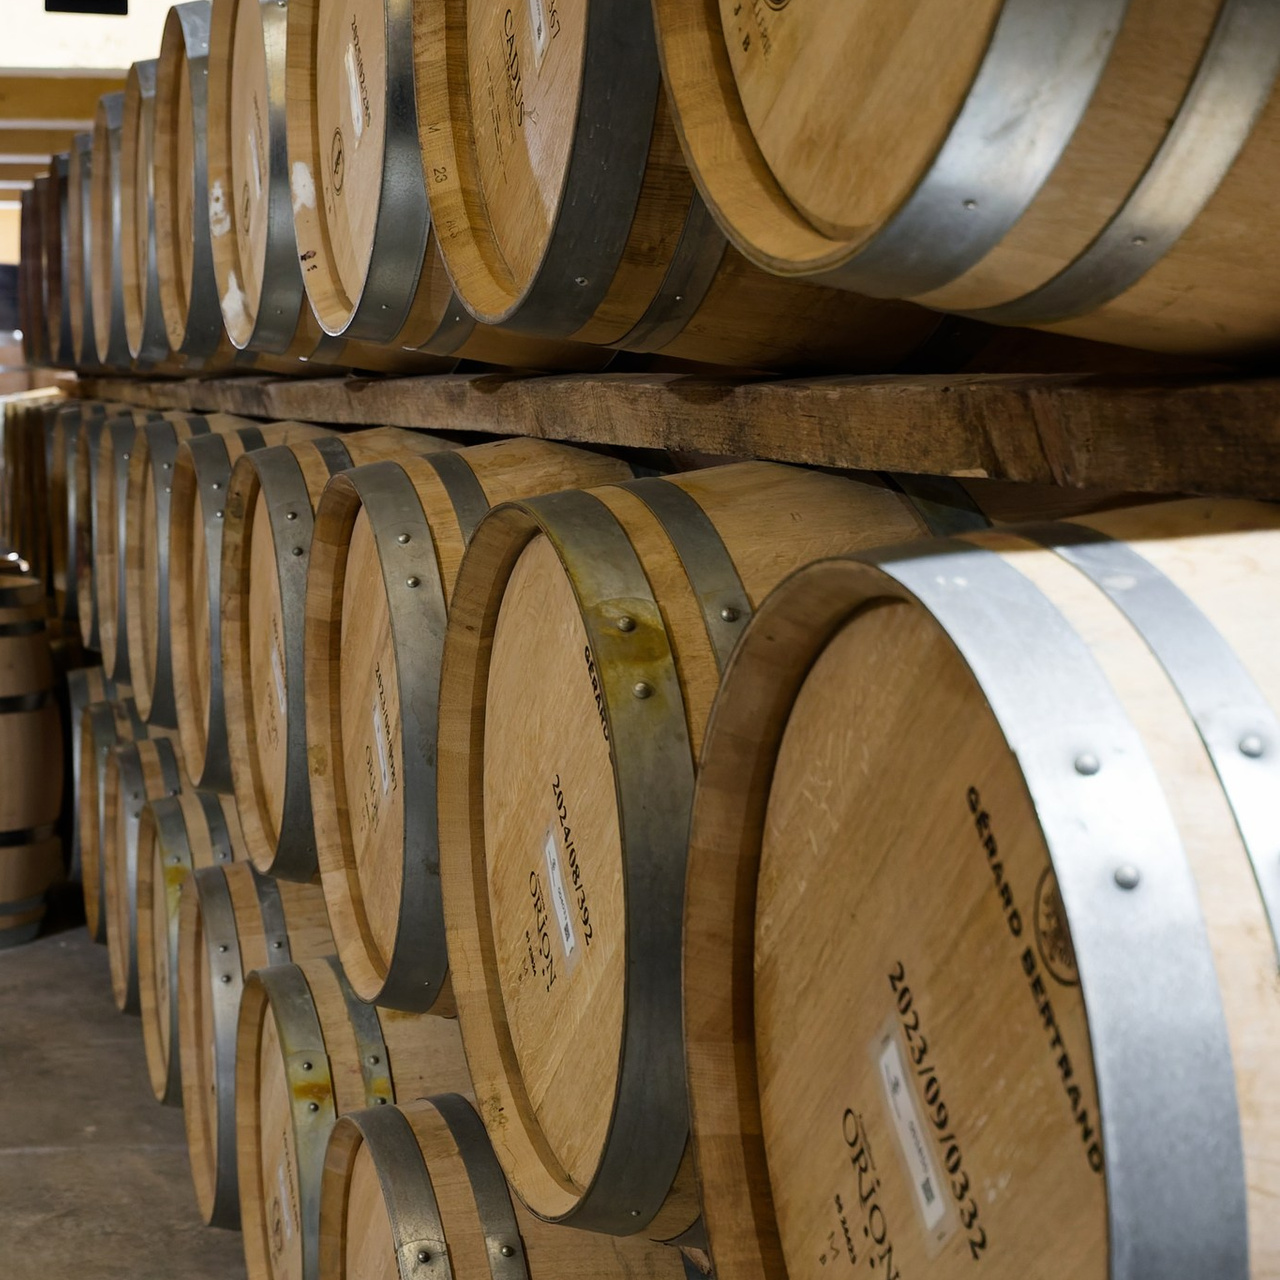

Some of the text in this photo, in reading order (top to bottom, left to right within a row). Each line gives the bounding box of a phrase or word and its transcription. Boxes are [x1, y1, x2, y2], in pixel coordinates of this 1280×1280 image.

[504, 9, 525, 127] CADUS
[433, 166, 447, 183] 23
[552, 774, 593, 946] 2024/08/392
[886, 960, 988, 1262] 2023/09/0332
[1020, 947, 1104, 1174] BERTRAND
